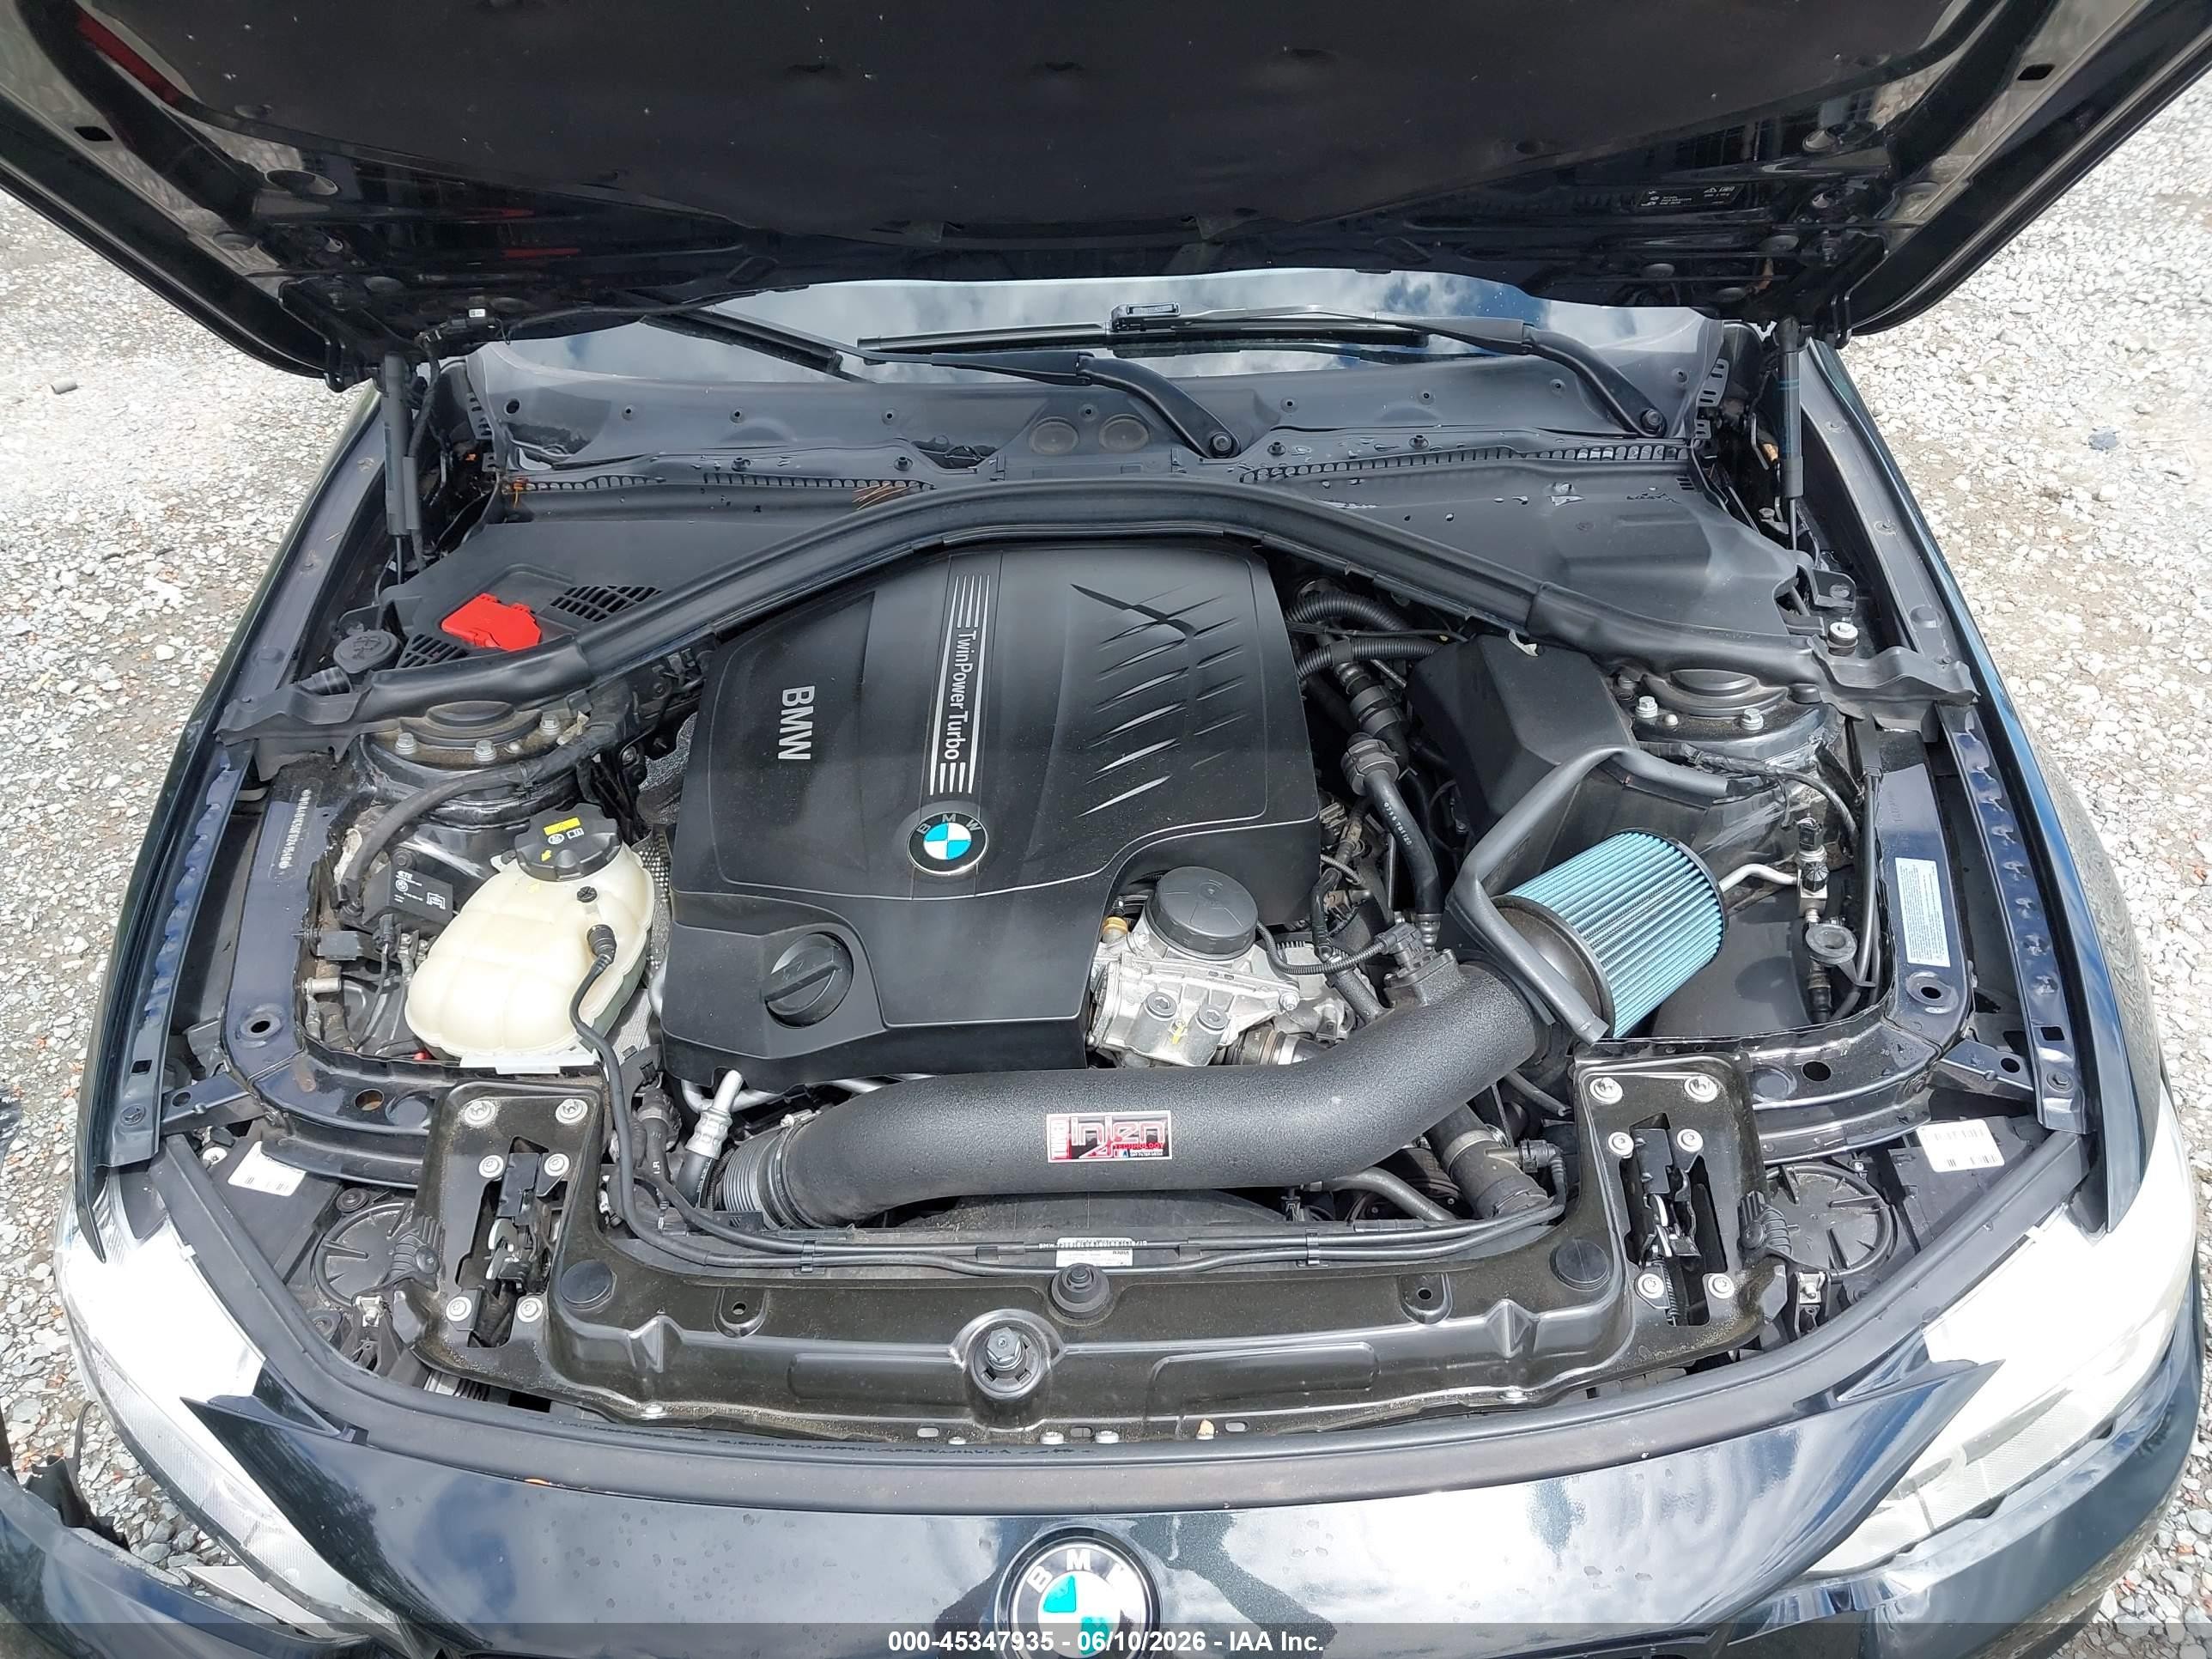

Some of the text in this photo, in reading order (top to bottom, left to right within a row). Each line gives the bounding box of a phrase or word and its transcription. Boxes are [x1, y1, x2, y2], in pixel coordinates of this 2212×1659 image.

[777, 685, 816, 760] BMW
[945, 630, 976, 760] TwinPower Turbo
[916, 813, 981, 836] BMW
